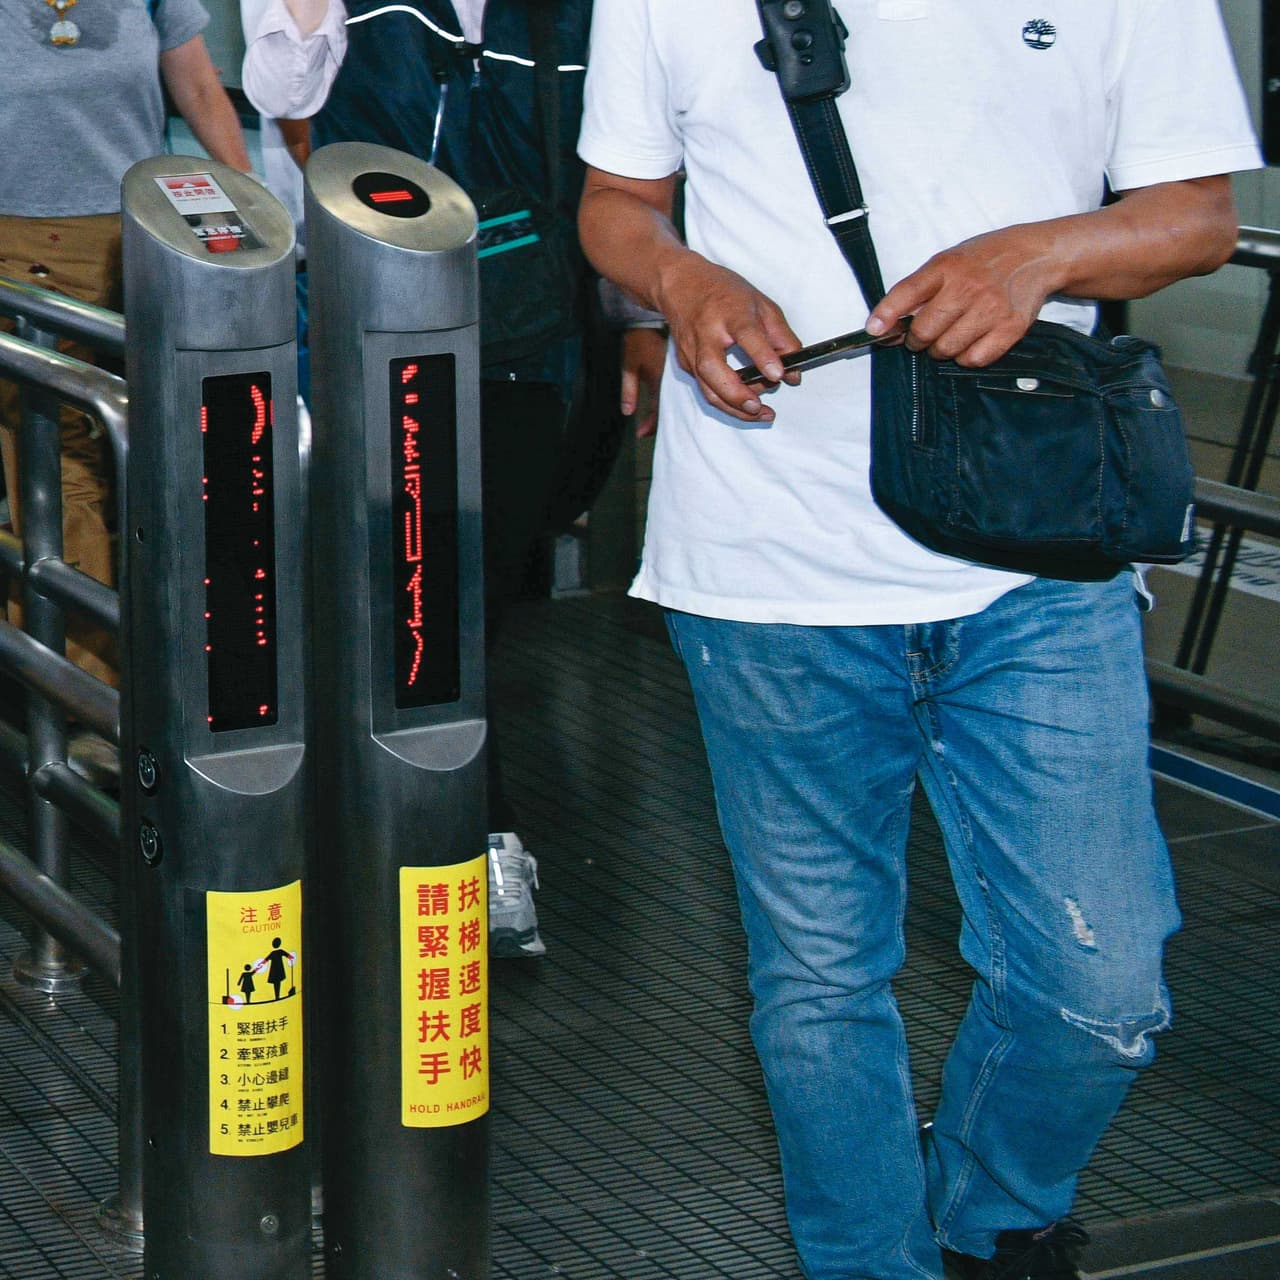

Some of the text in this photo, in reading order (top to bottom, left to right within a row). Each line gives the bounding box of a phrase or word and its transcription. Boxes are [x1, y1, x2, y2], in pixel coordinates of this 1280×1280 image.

[240, 903, 283, 924] 注意
[243, 923, 281, 934] CAUTION
[417, 882, 451, 1085] 請緊握扶手
[458, 875, 482, 1080] 扶梯速度快
[237, 1015, 289, 1036] 緊握扶手
[237, 1041, 289, 1061] 牽緊孩童
[237, 1092, 290, 1112] 禁止攀爬
[410, 1093, 485, 1114] HOLD HANDRA
